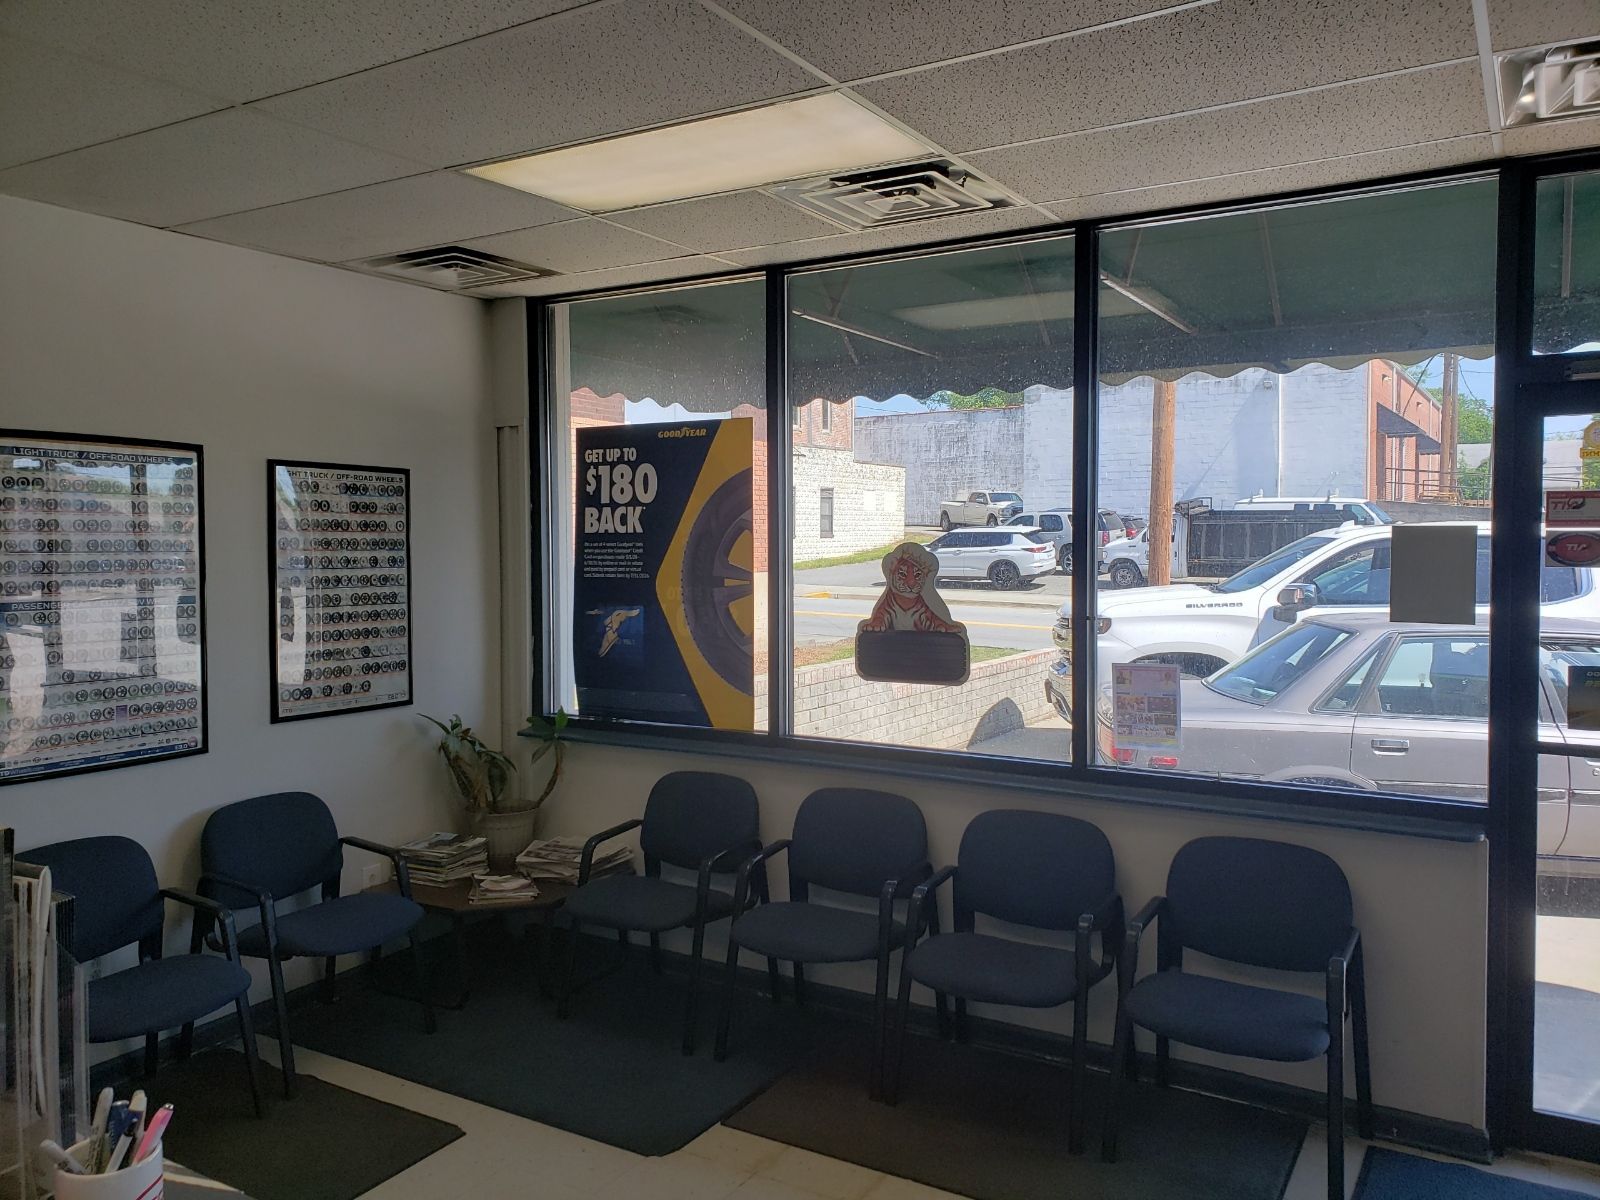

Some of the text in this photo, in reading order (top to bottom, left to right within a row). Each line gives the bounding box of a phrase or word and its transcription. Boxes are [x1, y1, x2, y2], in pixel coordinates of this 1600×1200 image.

[658, 427, 708, 439] GOODYEAR
[13, 447, 46, 457] LIGHT
[47, 449, 80, 459] TRUCK
[89, 452, 136, 462] OFF-ROAD
[138, 455, 174, 464] WHEELS
[585, 447, 637, 463] GET UP TO
[336, 473, 374, 482] OFF-ROAD
[374, 476, 404, 484] WHEELS
[586, 462, 658, 504] $180
[584, 506, 644, 534] BACK
